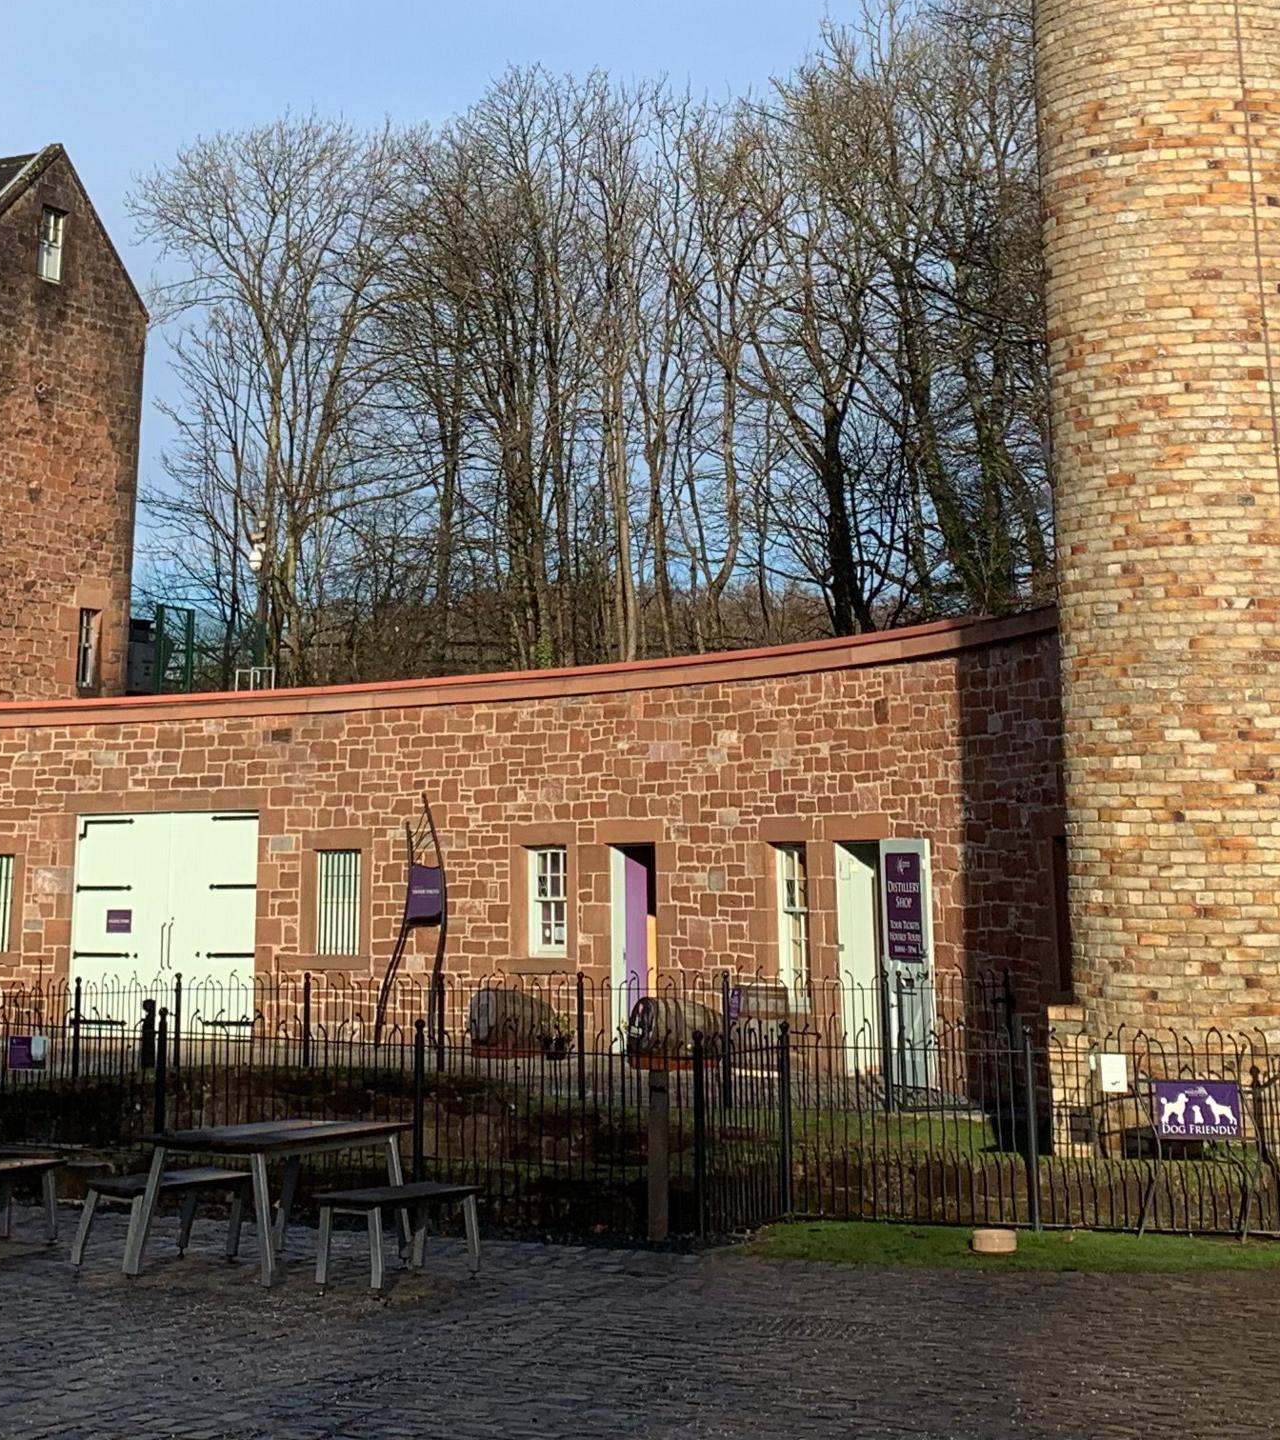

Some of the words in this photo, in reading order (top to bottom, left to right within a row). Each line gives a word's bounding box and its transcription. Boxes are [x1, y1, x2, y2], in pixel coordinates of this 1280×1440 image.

[888, 881, 919, 893] DISTILLERY
[895, 896, 912, 909] SHOP
[1162, 1124, 1186, 1134] DOG
[1189, 1124, 1237, 1135] FRIENDLY
